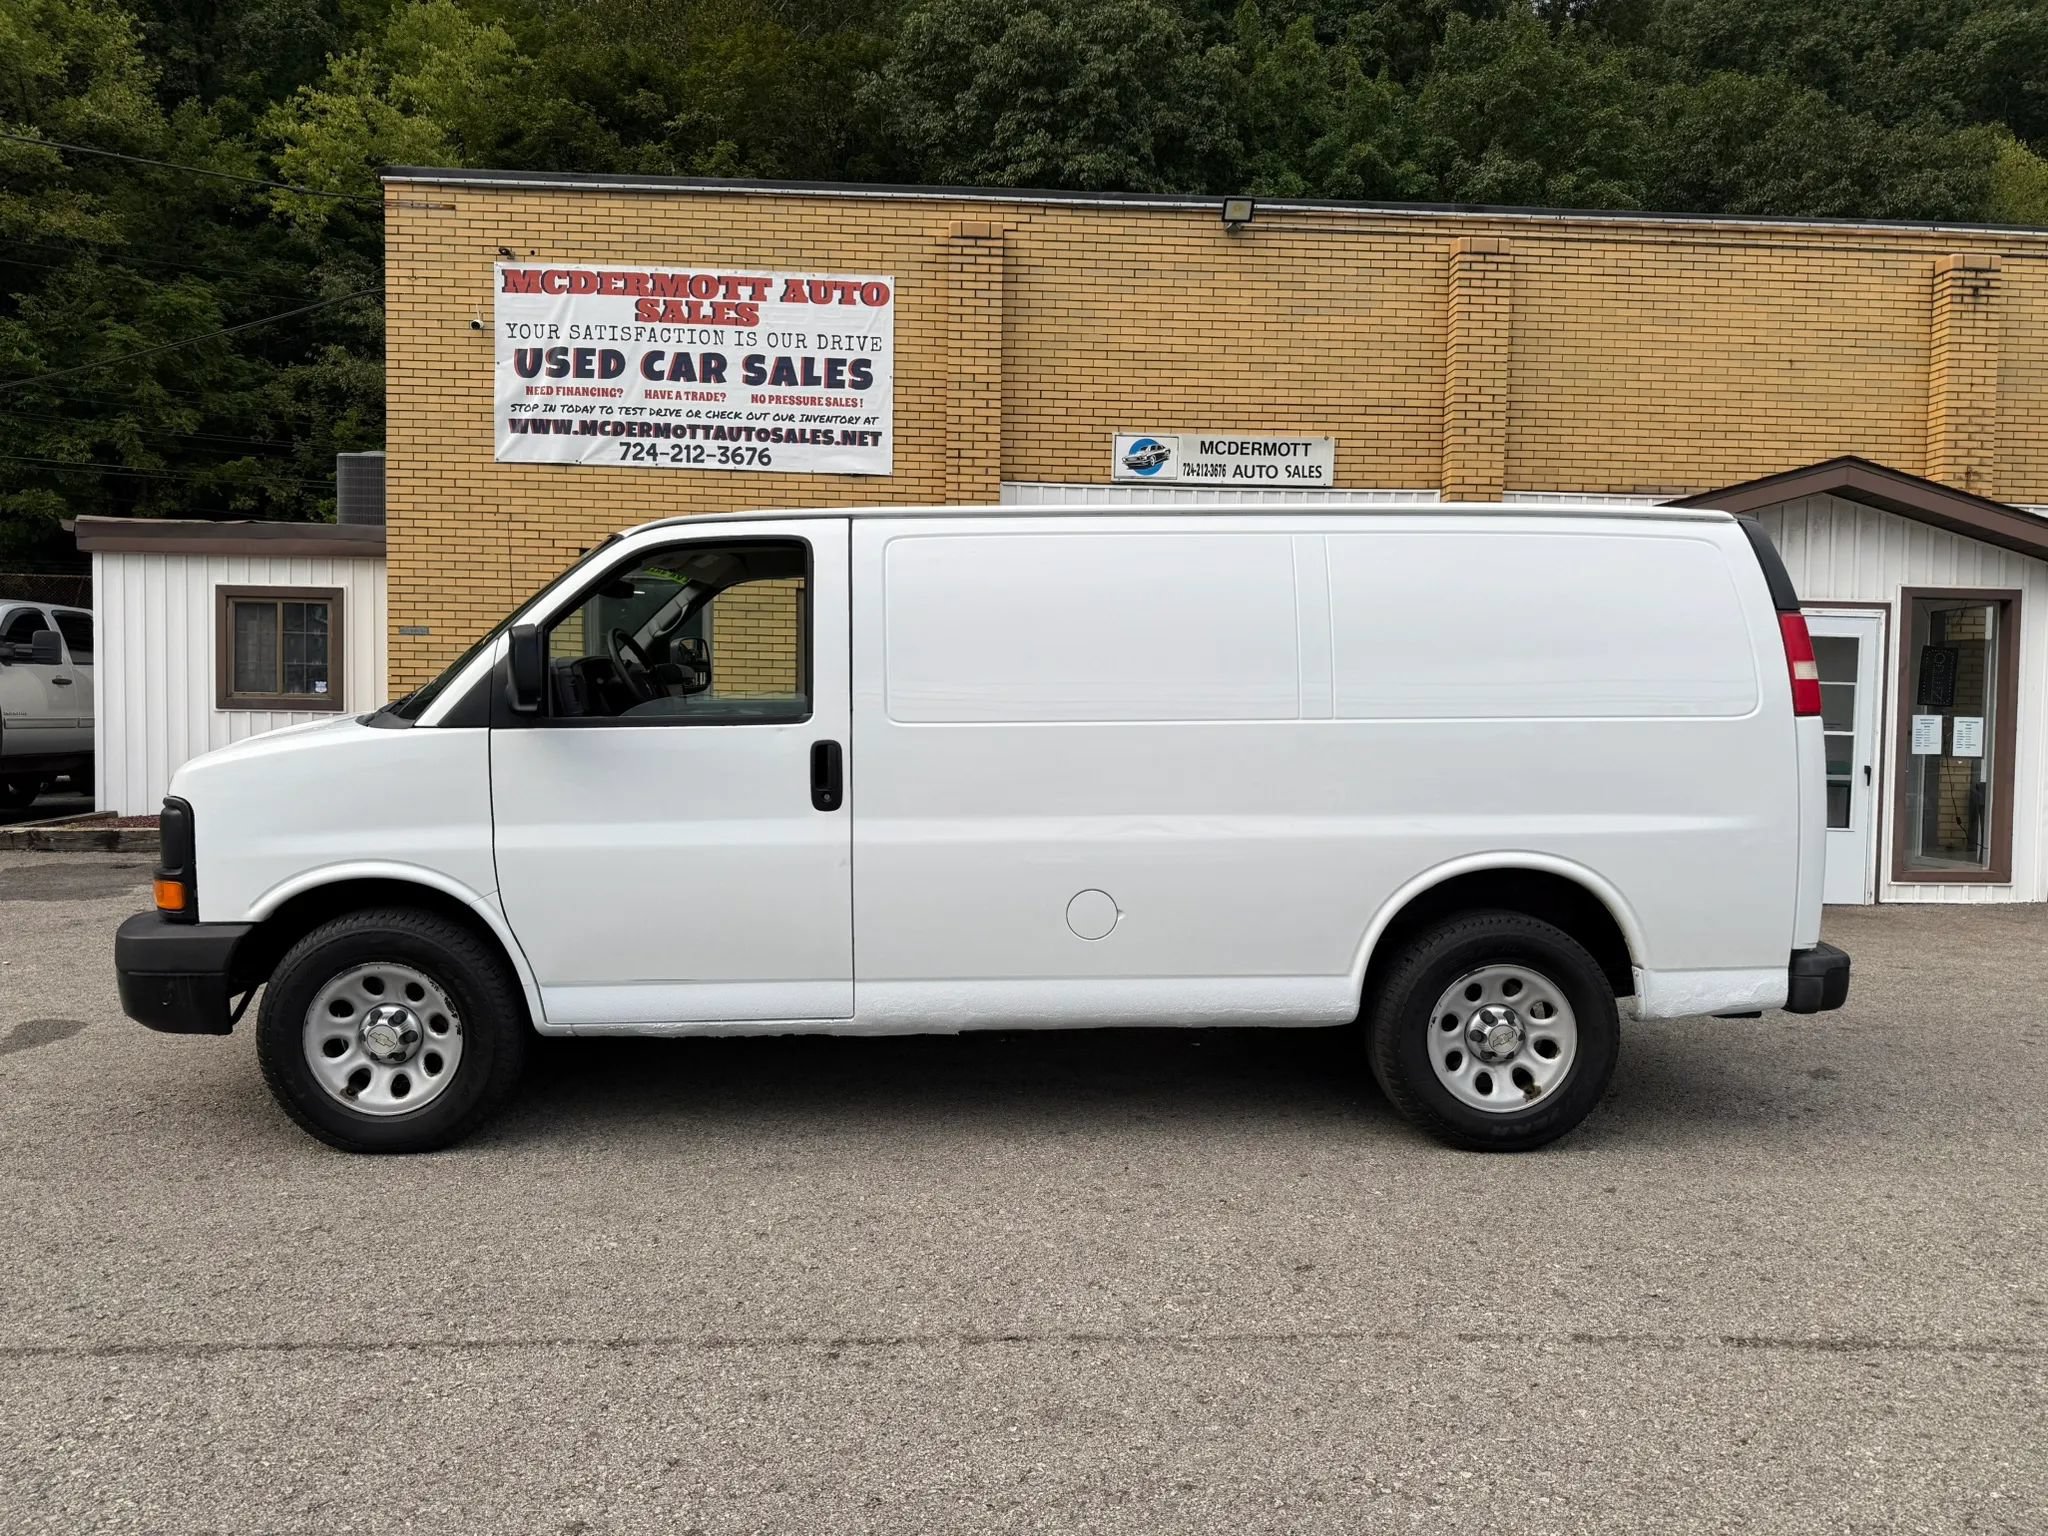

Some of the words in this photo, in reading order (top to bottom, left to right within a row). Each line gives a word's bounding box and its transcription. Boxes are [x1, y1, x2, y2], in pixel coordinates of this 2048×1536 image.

[501, 269, 773, 301] MCDERMOTT
[780, 279, 890, 306] AUTO
[635, 299, 760, 327] SALES
[506, 323, 561, 340] YOUR
[569, 325, 725, 345] SATISFACTION
[733, 331, 758, 346] IS
[767, 333, 808, 349] OUR
[817, 334, 883, 352] DRIVE
[514, 347, 626, 378] USED
[639, 350, 728, 383] CAR
[741, 353, 874, 390] SALES
[525, 385, 554, 396] NEED
[555, 386, 623, 399] FINANCING?
[644, 389, 672, 400] HAVE
[675, 391, 682, 400] A
[683, 391, 727, 402] TRADE?
[751, 394, 767, 404] NO
[768, 395, 823, 406] PRESSURE
[511, 403, 539, 413] STOP
[542, 404, 557, 414] IN
[560, 405, 596, 414] TODAY
[598, 405, 614, 415] TO
[618, 406, 647, 416] TEST
[649, 407, 682, 418] DRIVE
[686, 409, 702, 419] OR
[705, 410, 742, 420] CHECK
[746, 411, 770, 421] OUT
[773, 412, 796, 423] OUR
[798, 413, 861, 425] INVENTORY
[863, 416, 879, 425] AT
[509, 418, 882, 447] WWW.MCDERMOTTAUTOSALES.NET
[619, 442, 772, 466] 724-212-3676
[1200, 441, 1312, 457] MCDERMOTT
[1183, 463, 1226, 477] 724-212-3676
[1232, 464, 1279, 479] AUTO
[1285, 465, 1322, 479] SALES
